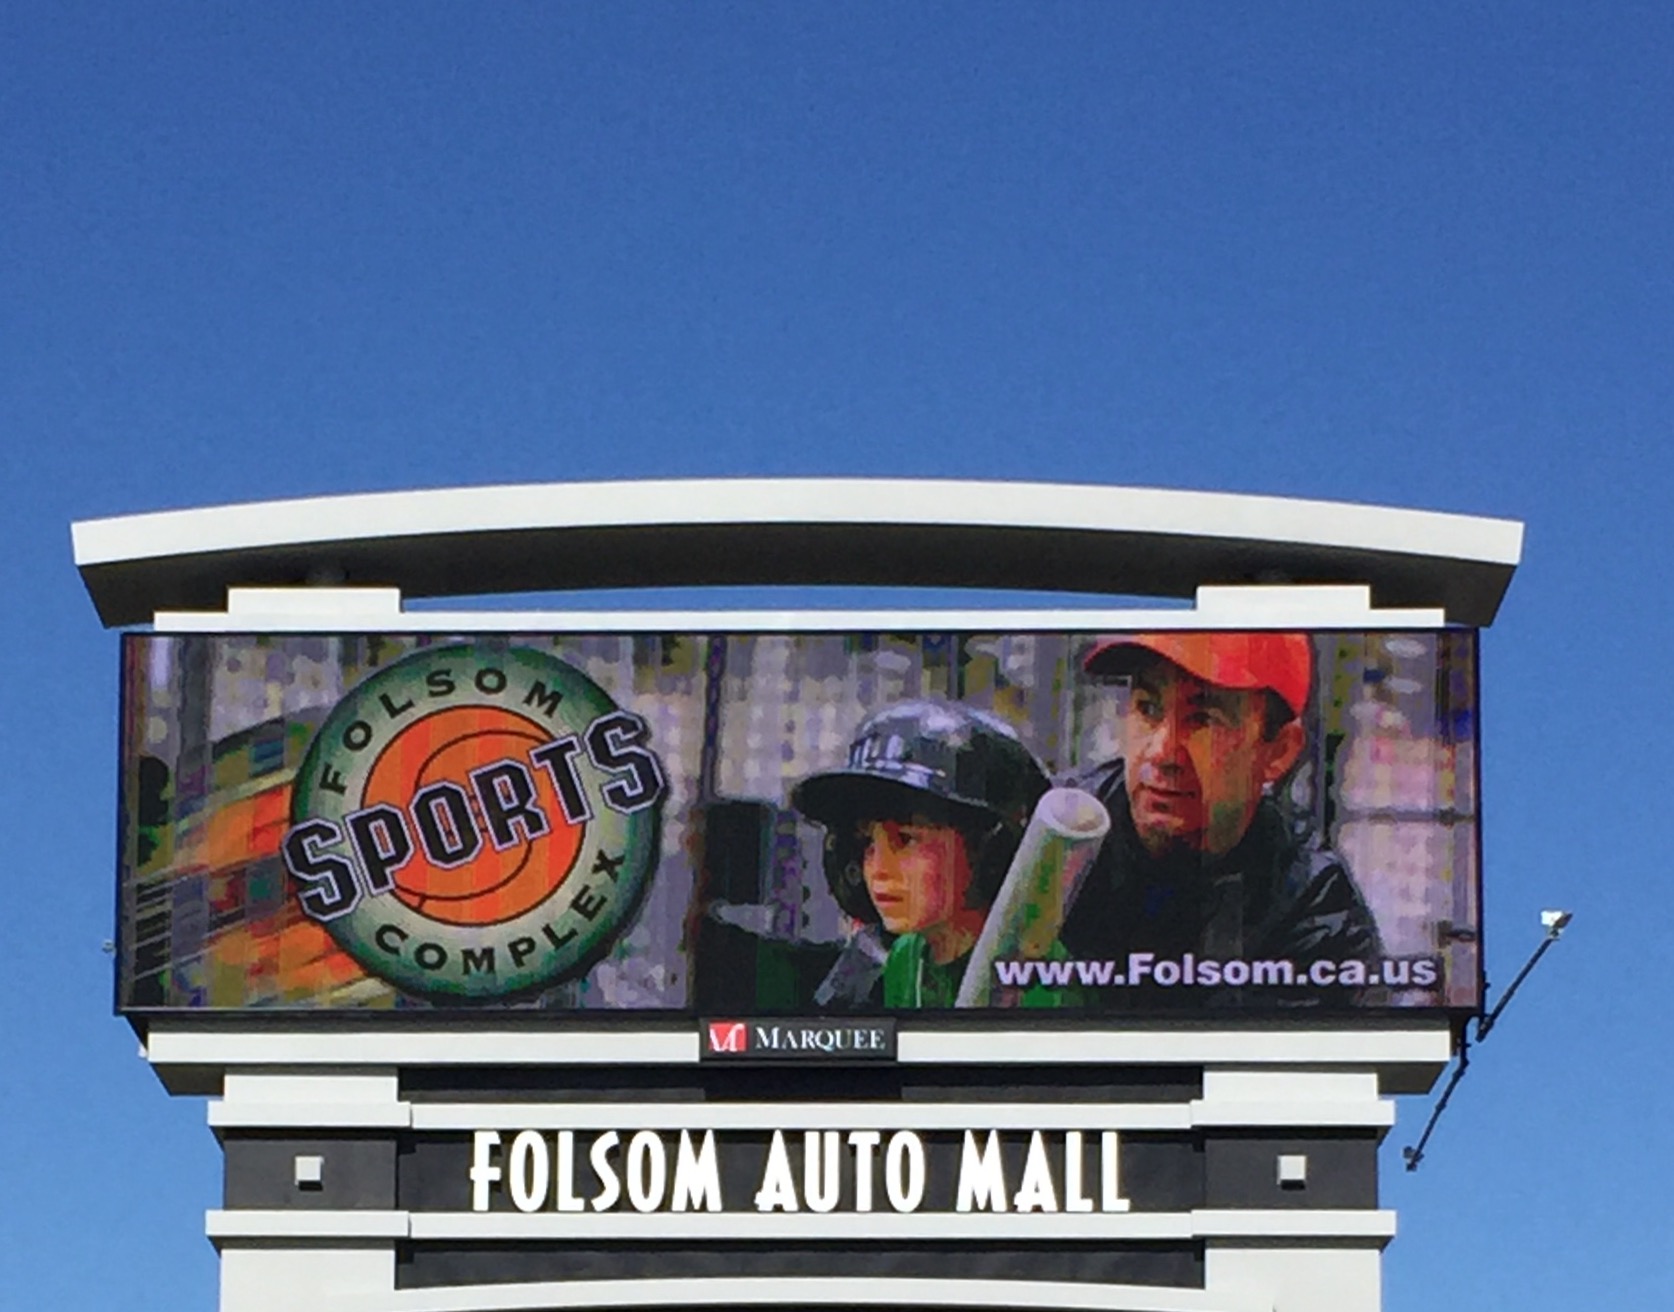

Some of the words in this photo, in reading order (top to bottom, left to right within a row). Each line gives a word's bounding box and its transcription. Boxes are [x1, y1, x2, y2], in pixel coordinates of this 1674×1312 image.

[321, 668, 562, 796] FOLSOM
[283, 711, 666, 920] SPORTS
[377, 848, 625, 976] COMPLEX
[994, 953, 1438, 986] www.Folsom.ca.us
[756, 1026, 886, 1052] MARQUEE
[470, 1129, 722, 1212] FOLSOM
[754, 1129, 925, 1212] AUTO
[956, 1129, 1131, 1212] MALL
